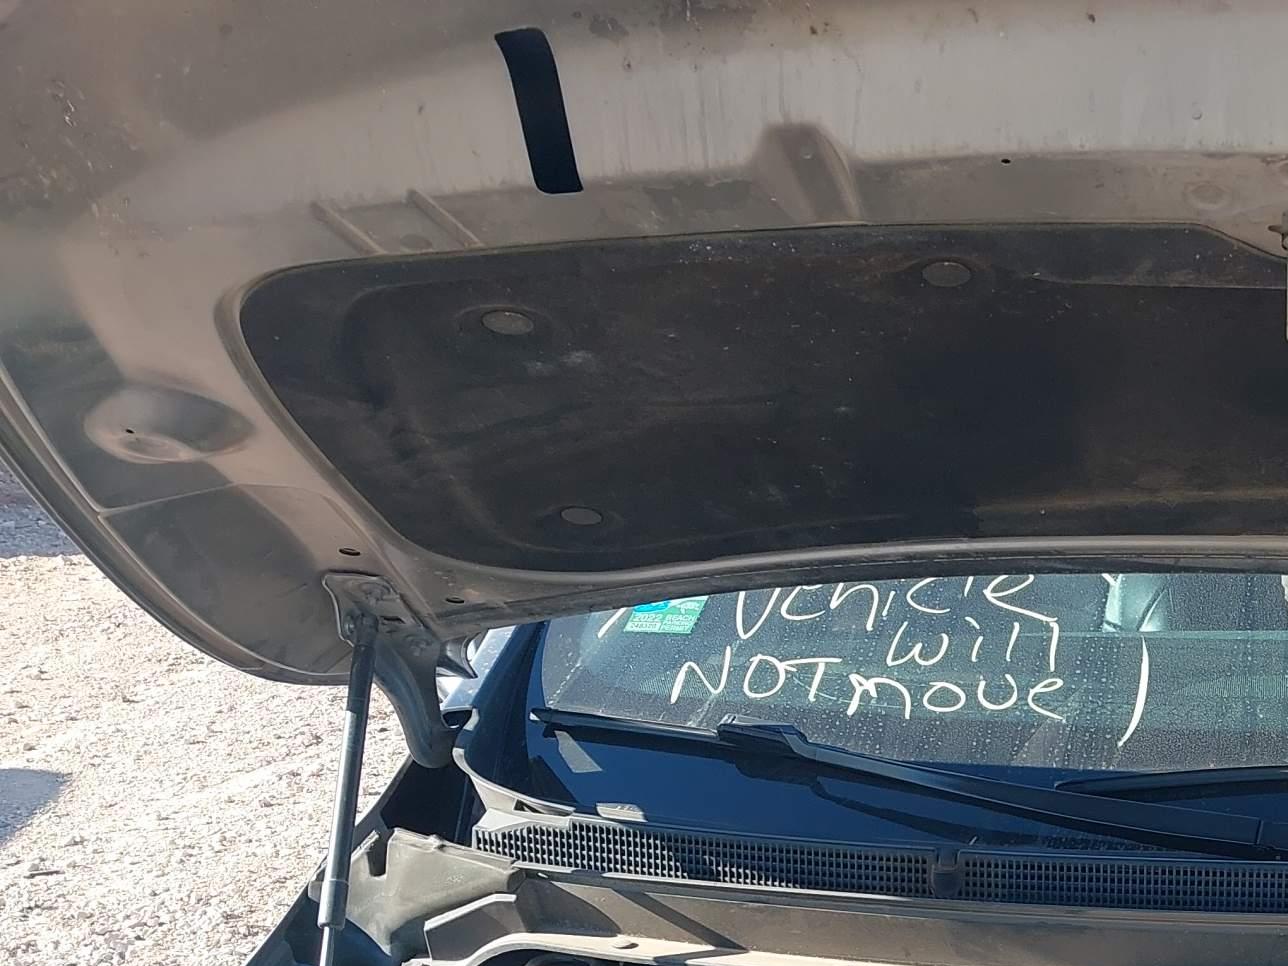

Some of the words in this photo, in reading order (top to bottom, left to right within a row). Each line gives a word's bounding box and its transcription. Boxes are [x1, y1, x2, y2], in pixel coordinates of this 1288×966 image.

[632, 613, 664, 622] 2022
[666, 614, 698, 622] BEACH
[671, 645, 842, 704] NOT
